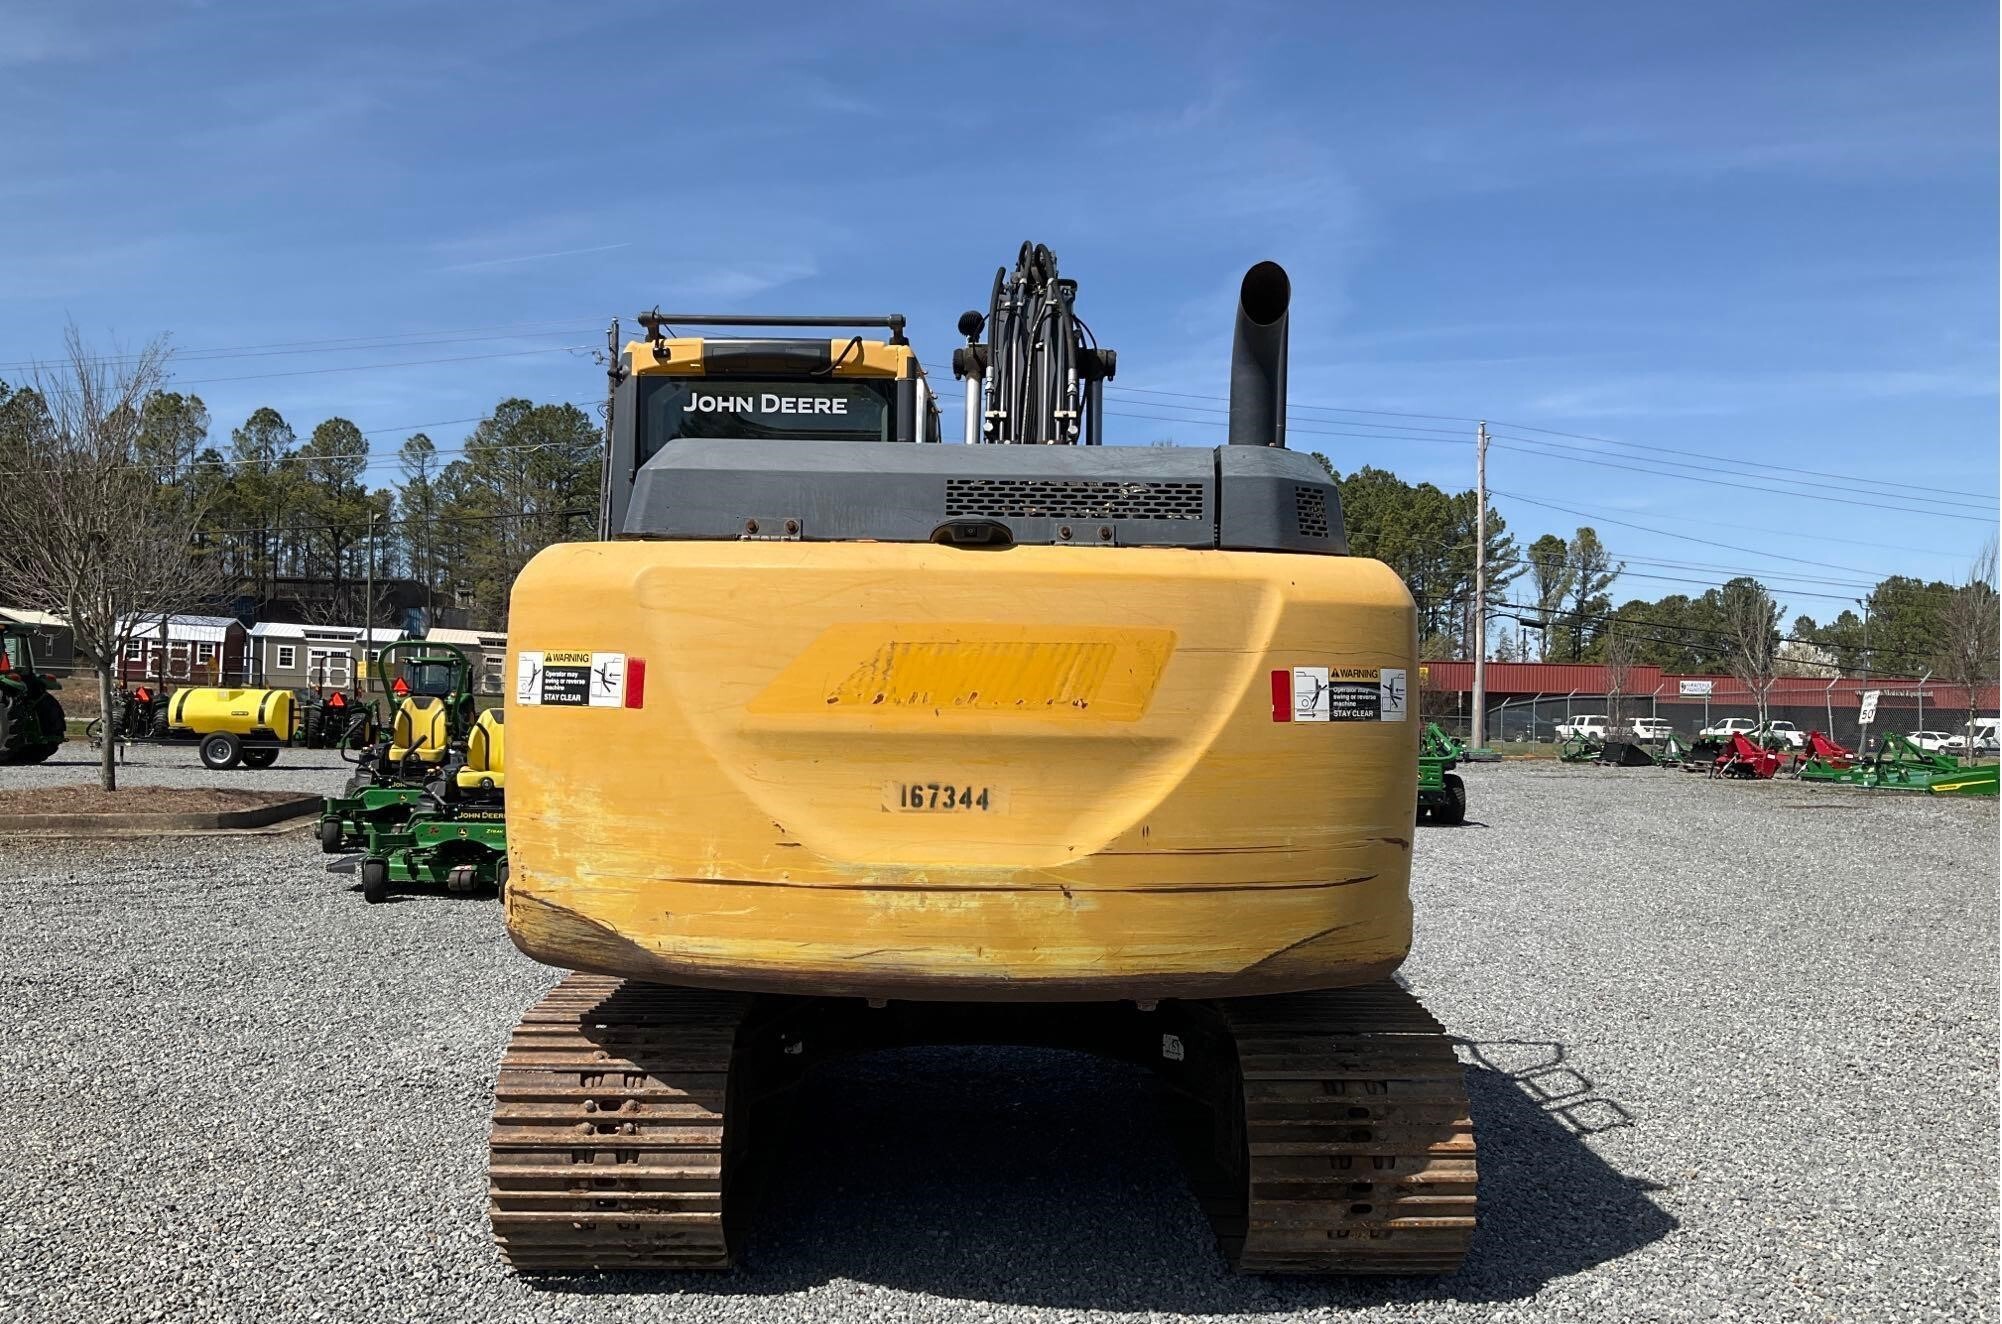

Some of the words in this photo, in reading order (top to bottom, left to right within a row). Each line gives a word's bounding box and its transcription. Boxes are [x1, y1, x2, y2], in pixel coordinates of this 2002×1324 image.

[683, 392, 753, 413] JOHN
[761, 393, 848, 414] DEERE
[553, 653, 589, 663] WARNING
[545, 670, 566, 678] Operator
[1340, 669, 1378, 679] WARNING
[544, 693, 559, 701] STAY
[560, 694, 581, 702] CLEAR
[1333, 709, 1351, 717] STAY
[1352, 709, 1374, 717] CLEAR
[1861, 709, 1874, 720] 50
[901, 783, 989, 811] 167344
[458, 811, 481, 819] JOHN
[482, 811, 506, 819] DEER
